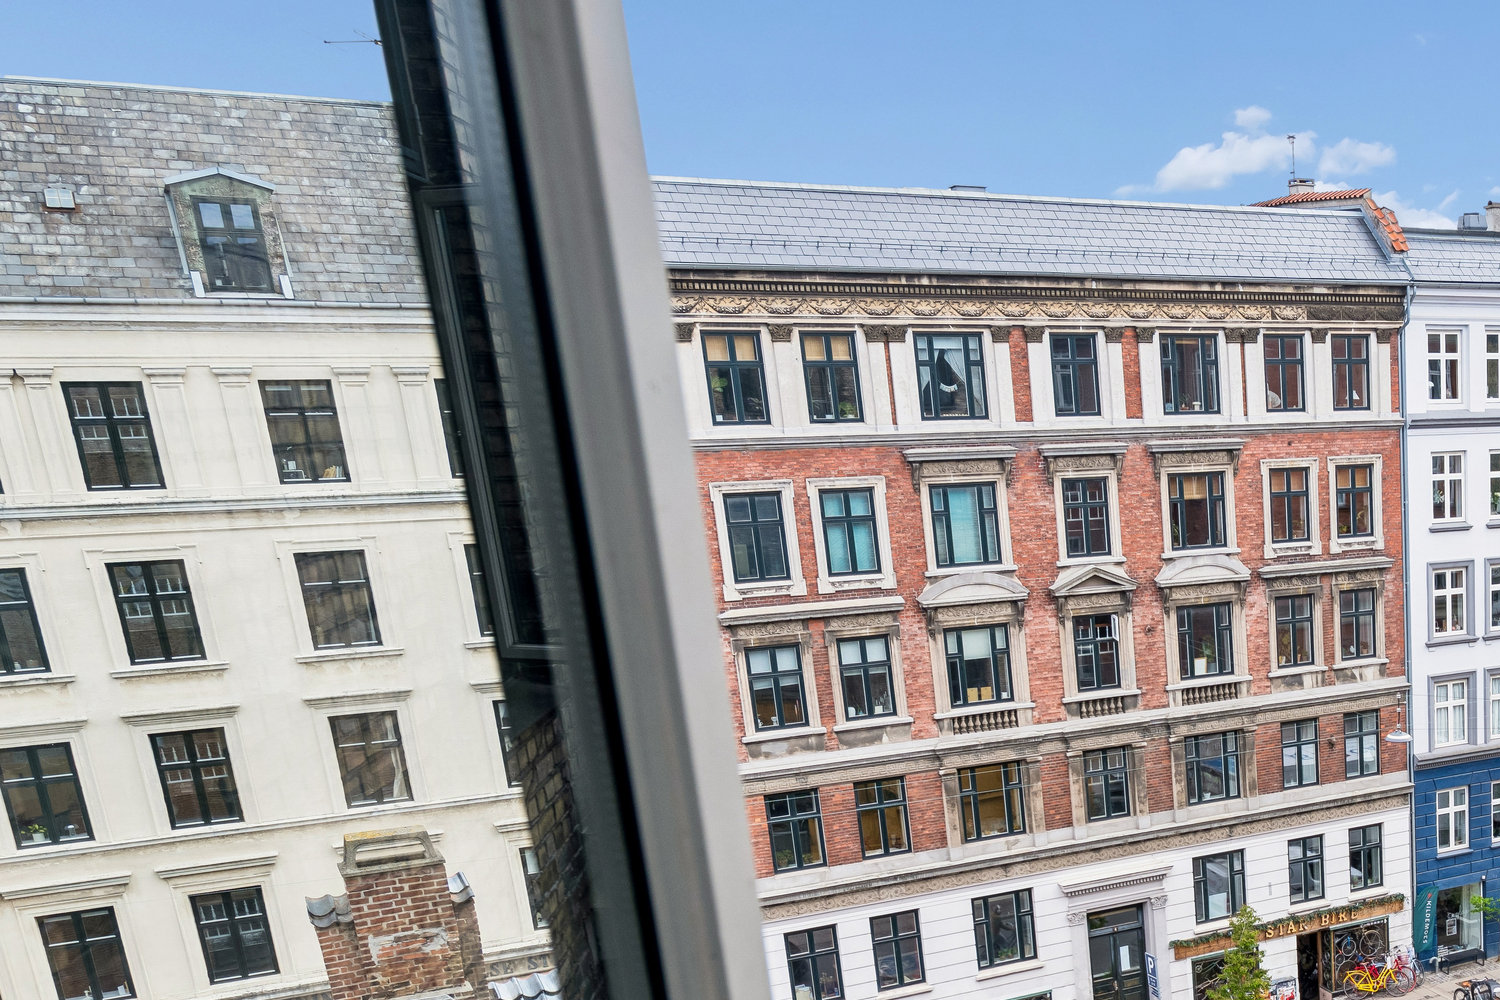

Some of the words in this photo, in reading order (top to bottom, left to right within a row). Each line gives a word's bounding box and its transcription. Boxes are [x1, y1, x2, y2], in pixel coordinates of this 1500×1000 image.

[1266, 920, 1308, 938] STAR
[1321, 910, 1359, 926] BIKE
[1148, 955, 1154, 974] P
